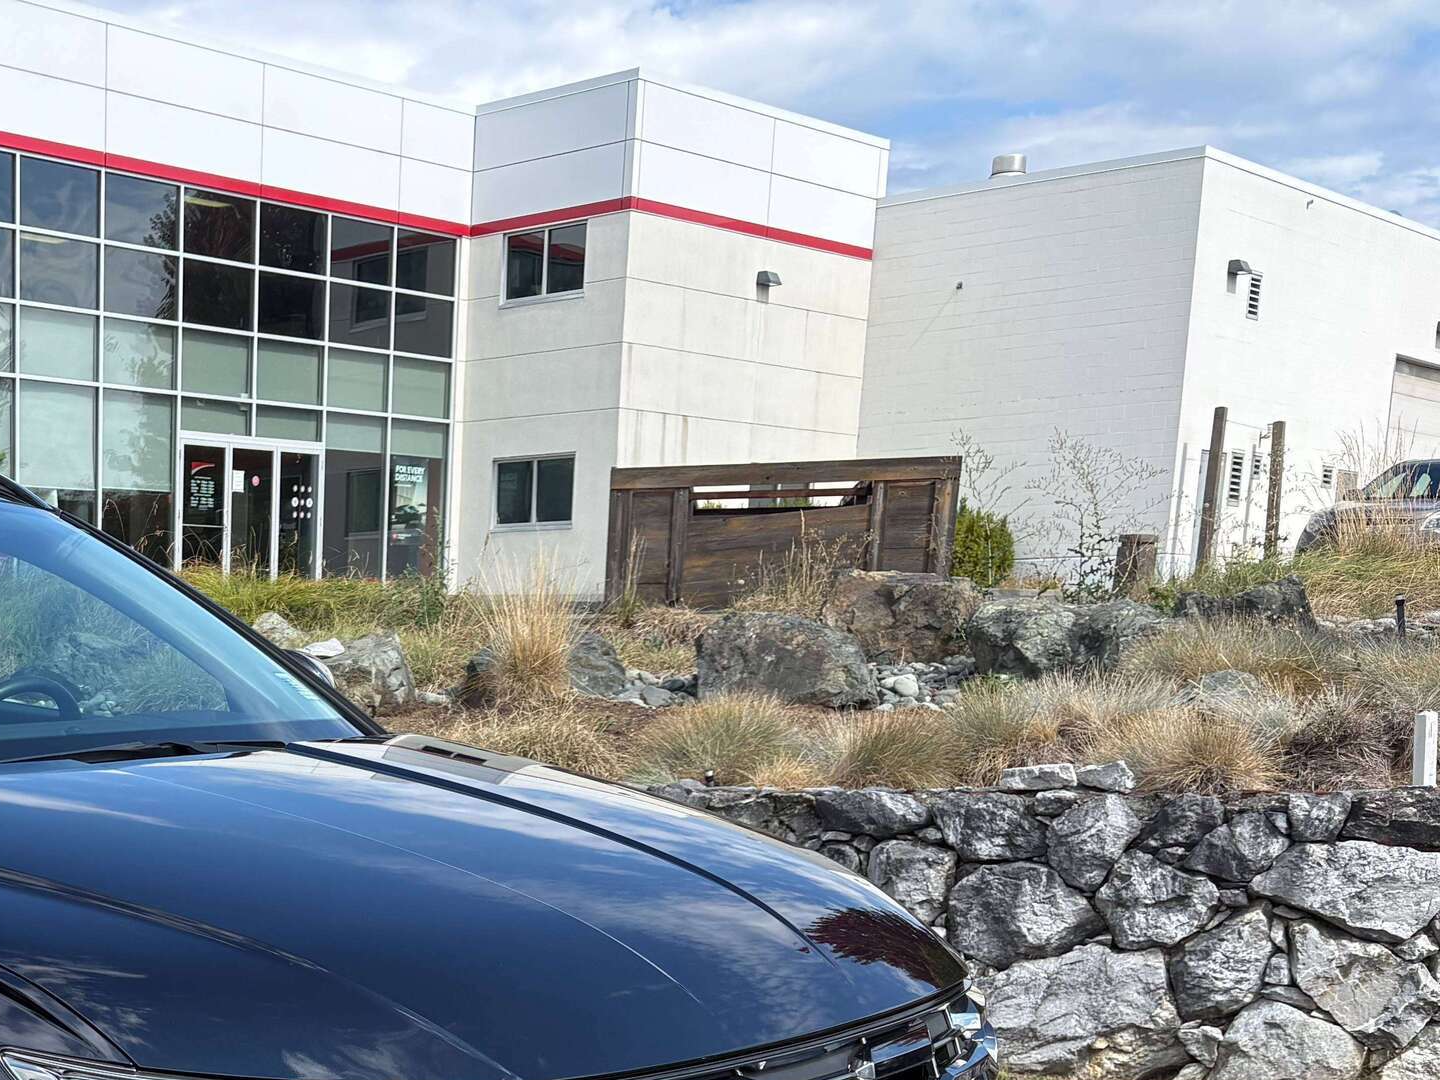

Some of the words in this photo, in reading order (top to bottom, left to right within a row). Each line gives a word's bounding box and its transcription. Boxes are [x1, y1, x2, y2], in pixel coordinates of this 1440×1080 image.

[395, 464, 406, 473] FOR
[407, 466, 426, 475] EVERY
[394, 473, 424, 483] DISTANCE
